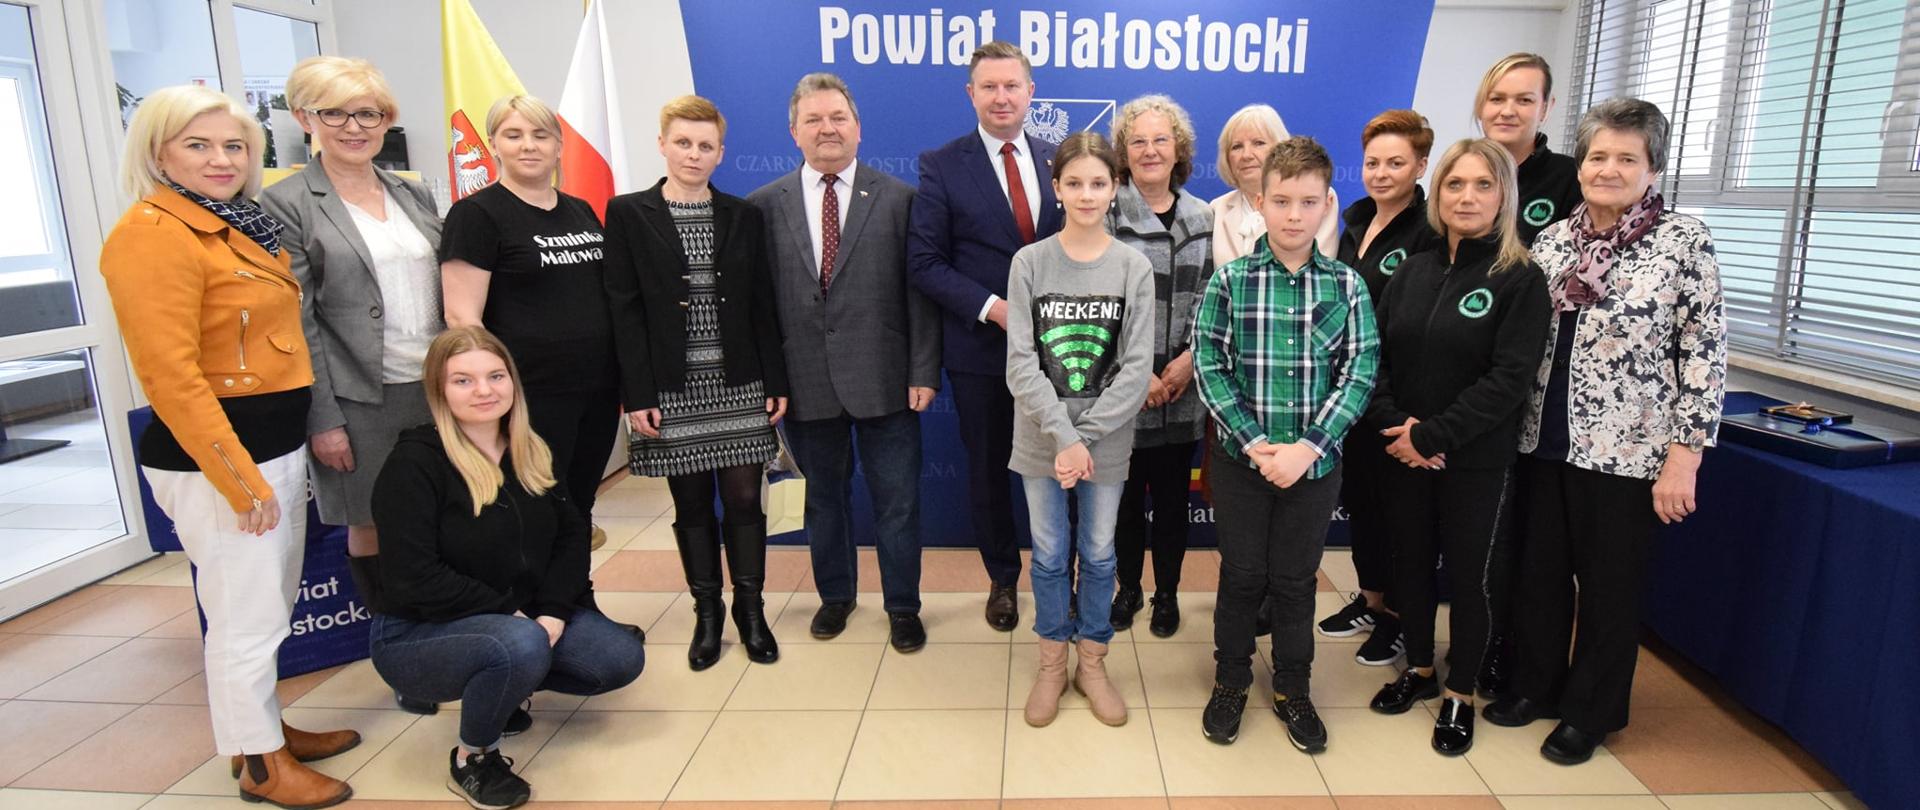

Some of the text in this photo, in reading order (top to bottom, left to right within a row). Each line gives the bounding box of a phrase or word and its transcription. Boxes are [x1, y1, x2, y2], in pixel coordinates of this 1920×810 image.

[819, 7, 1309, 73] Powiat Białostocki
[735, 154, 798, 172] CZARN
[1039, 301, 1121, 320] WEEKEND
[294, 576, 339, 604] iat
[292, 601, 372, 636] stock
